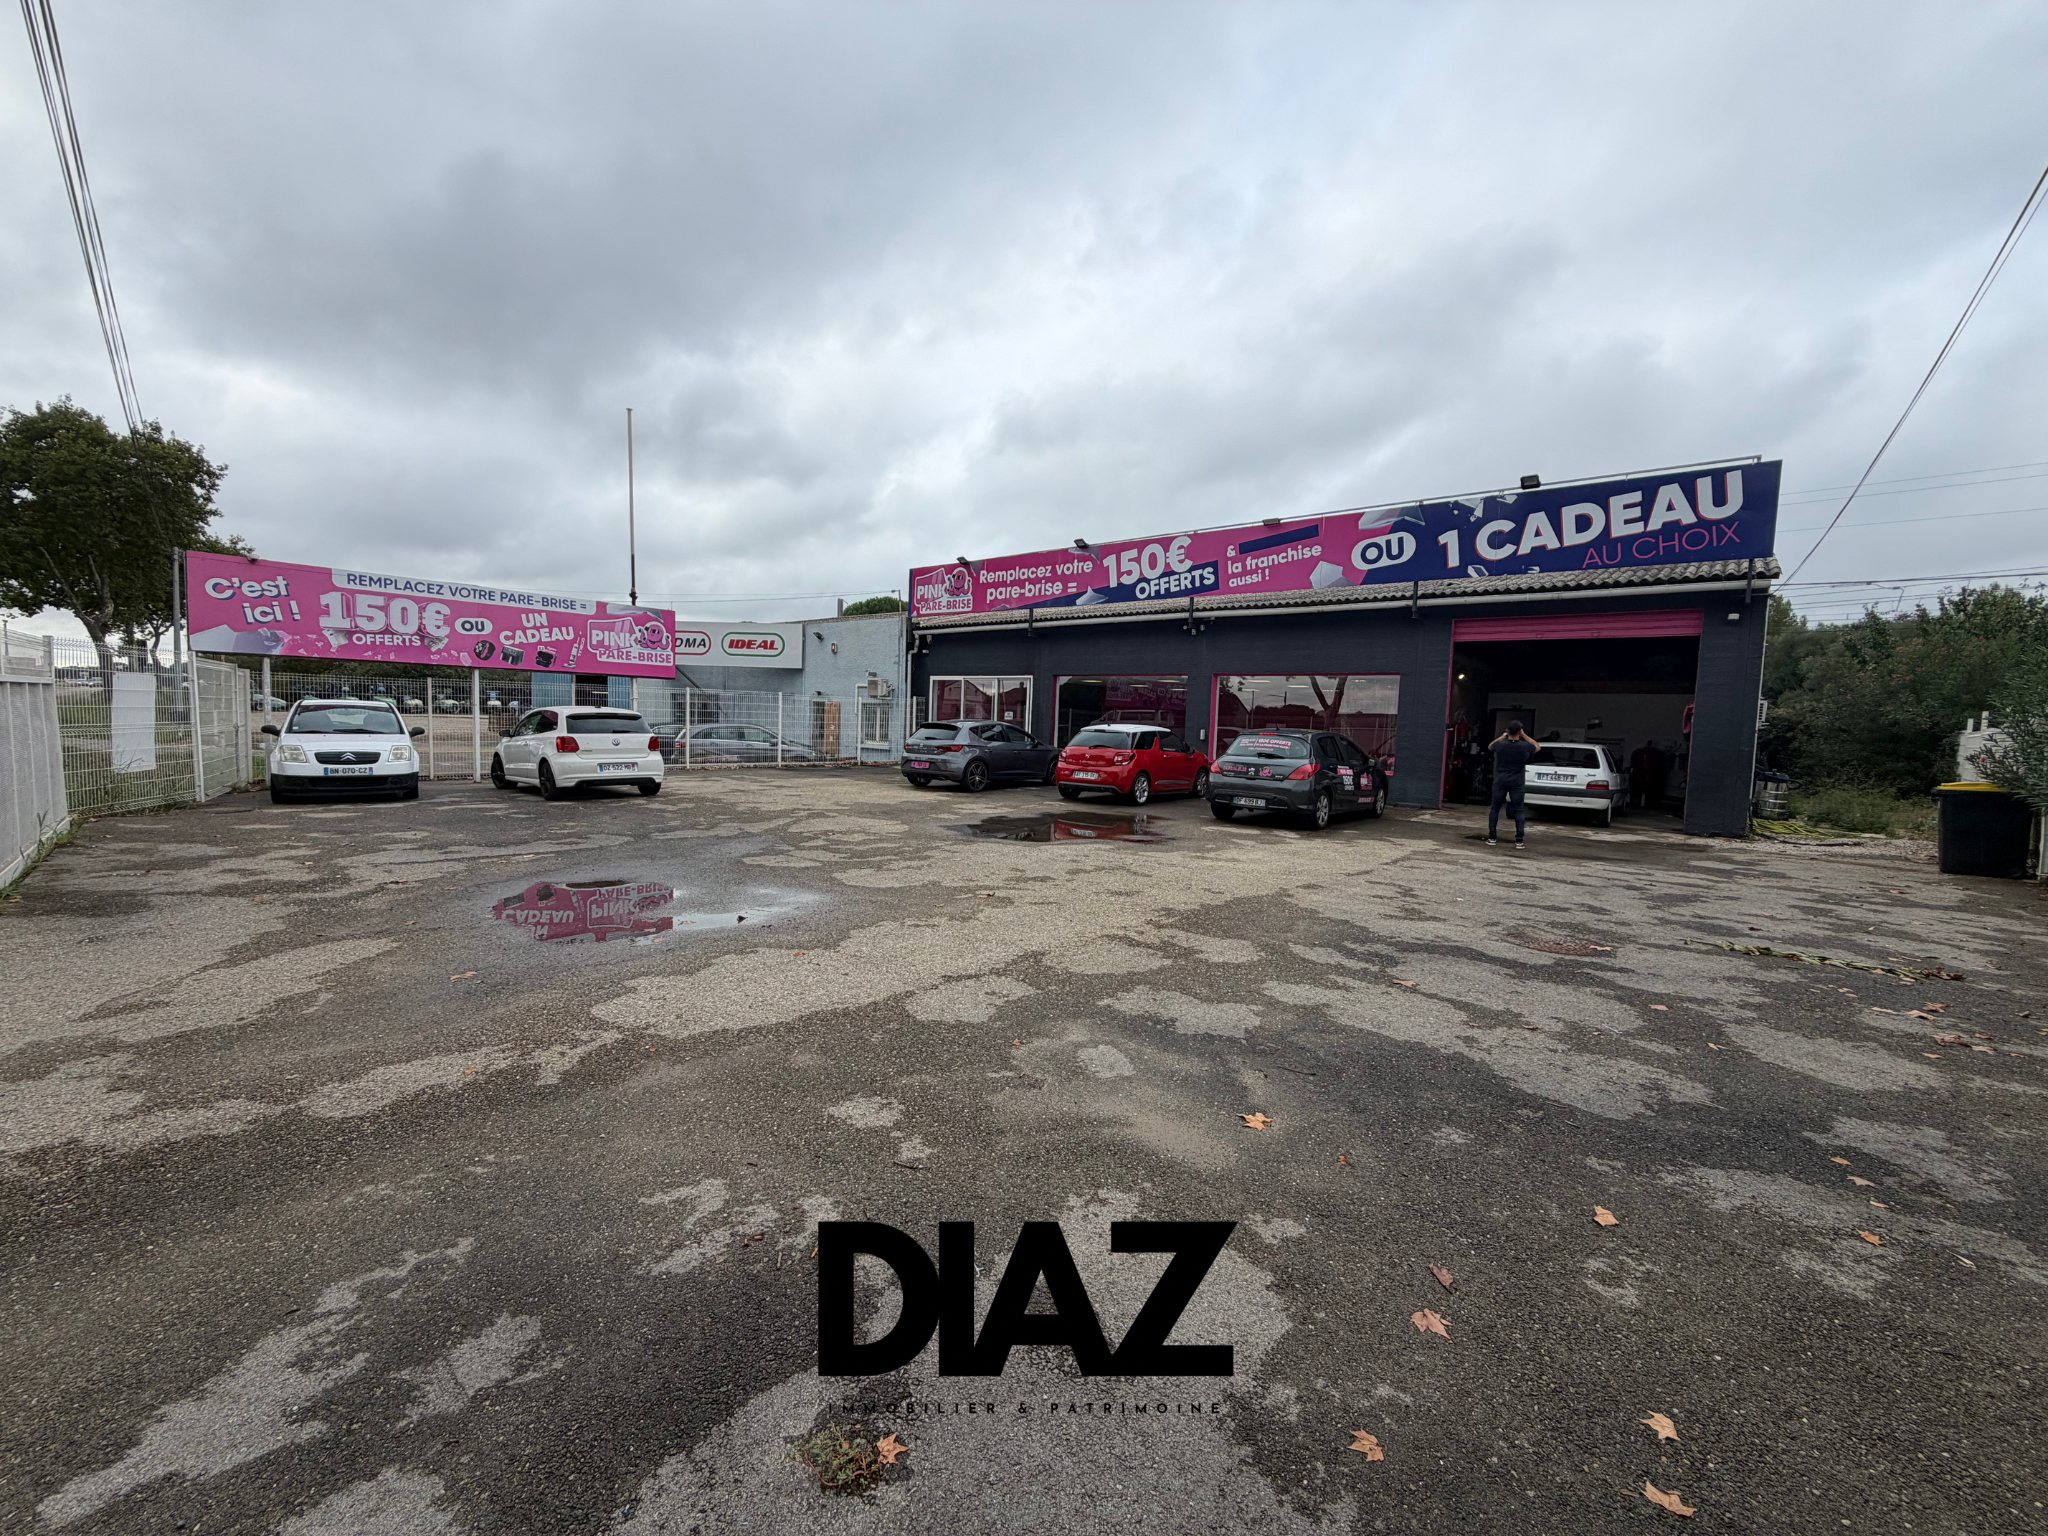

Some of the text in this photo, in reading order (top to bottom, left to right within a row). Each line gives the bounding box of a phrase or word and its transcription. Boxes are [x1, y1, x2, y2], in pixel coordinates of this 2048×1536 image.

[1361, 469, 1744, 569] OU 1 CADEAU
[1226, 545, 1236, 557] &
[1582, 521, 1741, 568] AU CHOIX
[1103, 536, 1193, 588] 150€
[1227, 544, 1322, 575] la franchise
[979, 560, 1093, 584] Remplacez votre
[1135, 566, 1216, 599] OFFERTS
[1229, 570, 1262, 587] aussi
[204, 575, 289, 600] C'est
[347, 573, 445, 596] REMPLACEZ
[448, 585, 496, 602] VOTRE
[500, 592, 577, 611] PARE-BRISE
[916, 583, 948, 600] PINK
[987, 580, 1063, 603] pare-brise
[242, 601, 283, 624] ici
[319, 591, 451, 637] 150€
[920, 599, 972, 612] PARE-BRISE
[461, 620, 486, 632] OU
[521, 613, 548, 627] UN
[352, 633, 422, 647] OFFERTS
[499, 626, 575, 645] CADEAU
[592, 629, 637, 648] PINK
[728, 638, 779, 650] IDEAL
[599, 649, 672, 664] PARE-BRISE
